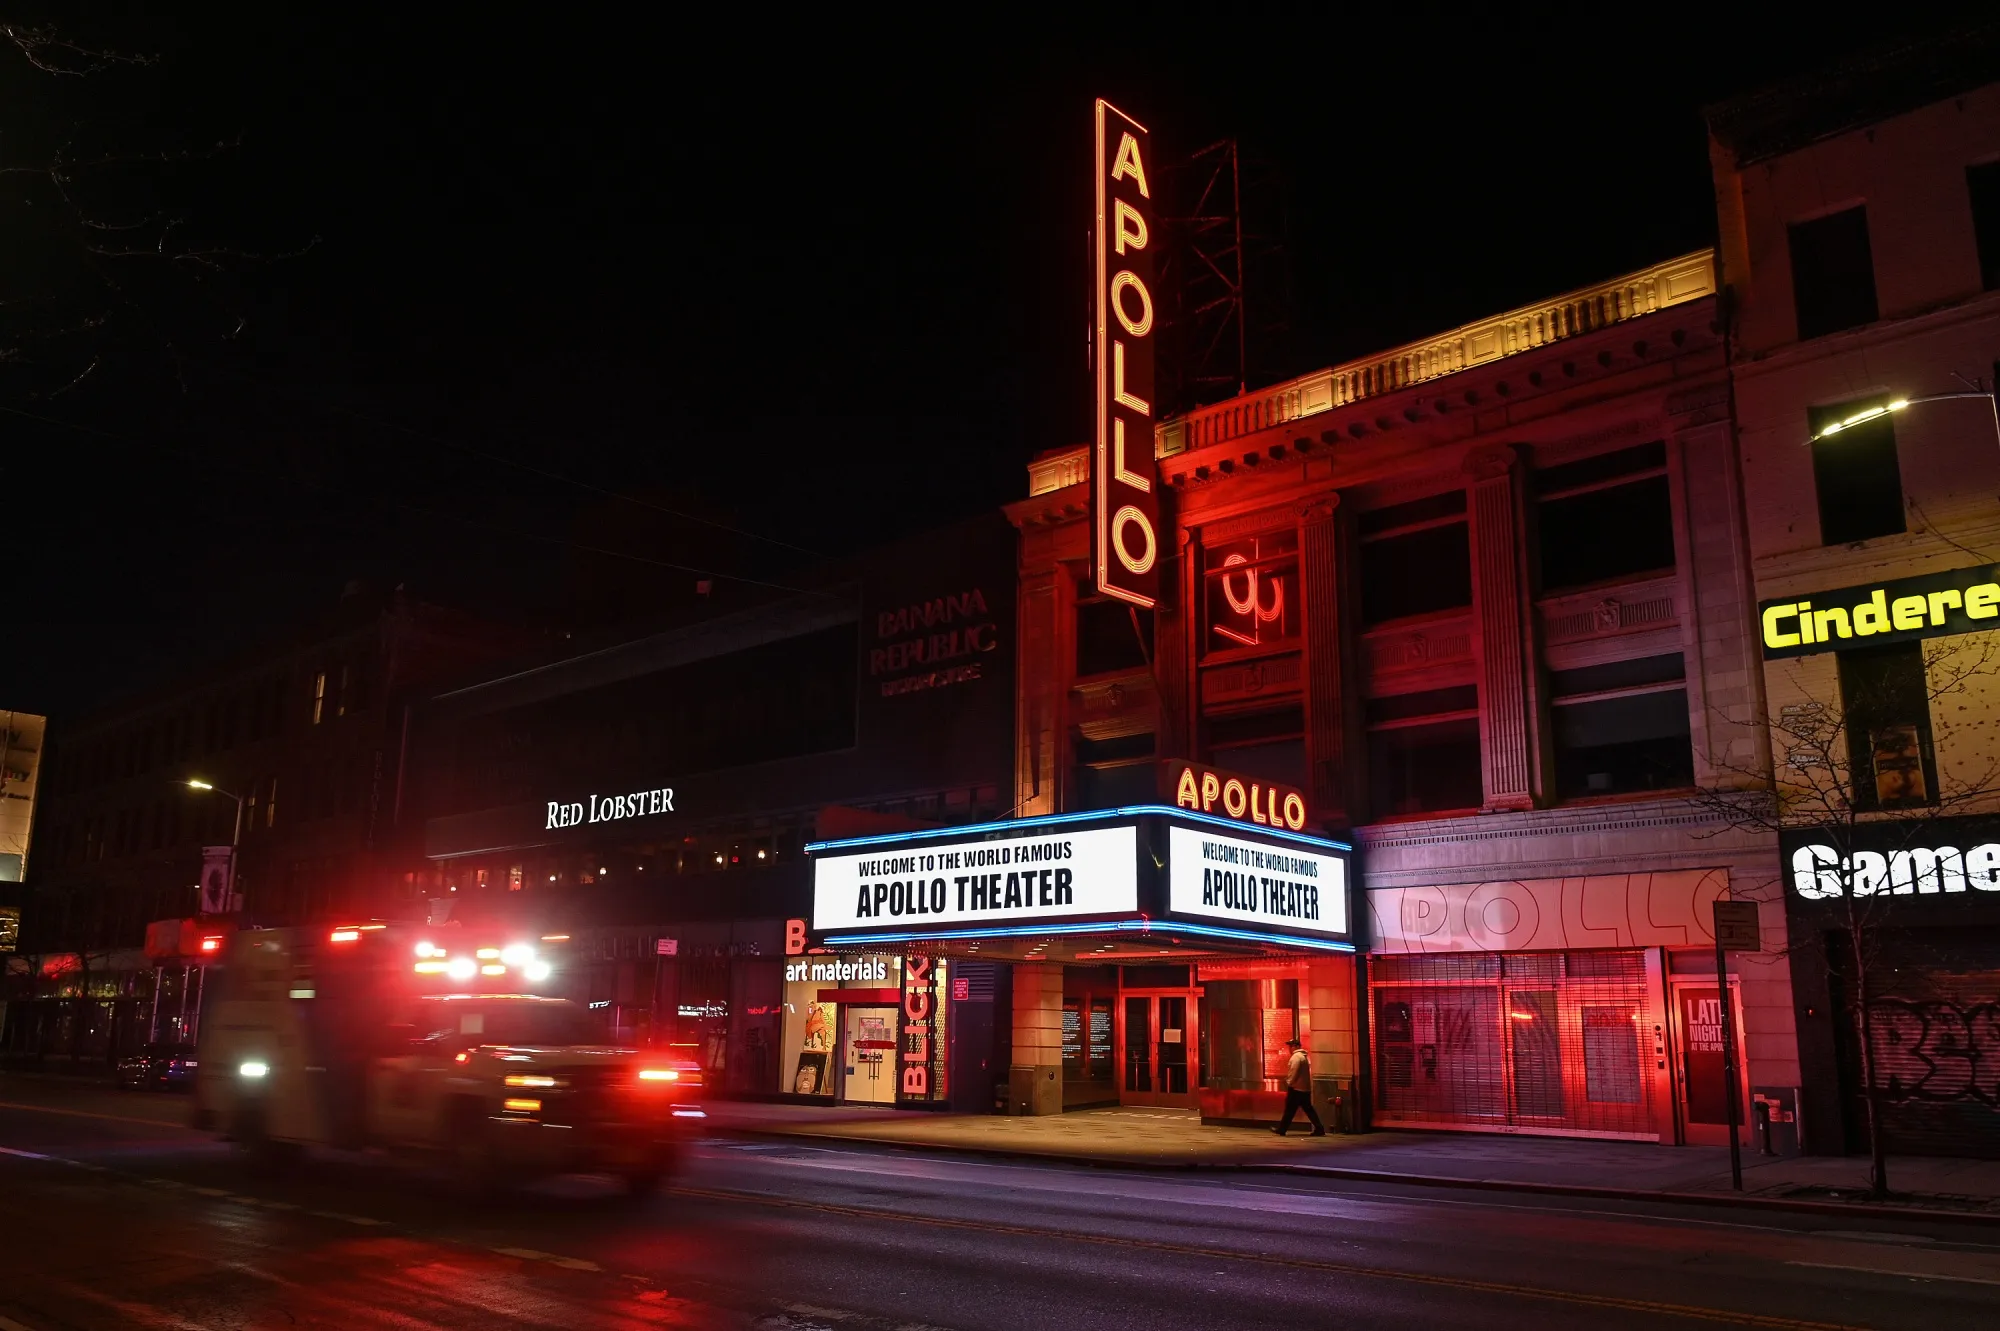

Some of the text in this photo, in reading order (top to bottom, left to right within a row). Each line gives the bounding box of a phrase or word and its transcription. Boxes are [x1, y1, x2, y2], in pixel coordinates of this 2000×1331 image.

[1110, 131, 1156, 574] APOLLO
[877, 587, 988, 638] BANANA
[1762, 583, 2000, 649] Cindere
[869, 623, 997, 676] REPUBLIC
[545, 788, 674, 829] RED LOBSTER
[1177, 768, 1305, 831] APOLLO
[858, 841, 1073, 877] WELCOME TO THE WORLD FAMOUS
[1202, 841, 1318, 878] WELCOME TO THE WORLD FAMOUS
[1792, 842, 2000, 900] Game
[856, 868, 1073, 918] APOLLO THEATER
[1202, 867, 1319, 920] APOLLO THEATER
[1366, 868, 1731, 953] POLL
[786, 956, 887, 981] art materials
[904, 956, 930, 1094] BLICK
[1689, 1025, 1722, 1042] NIGHT
[1691, 1042, 1725, 1052] AT THE APOL
